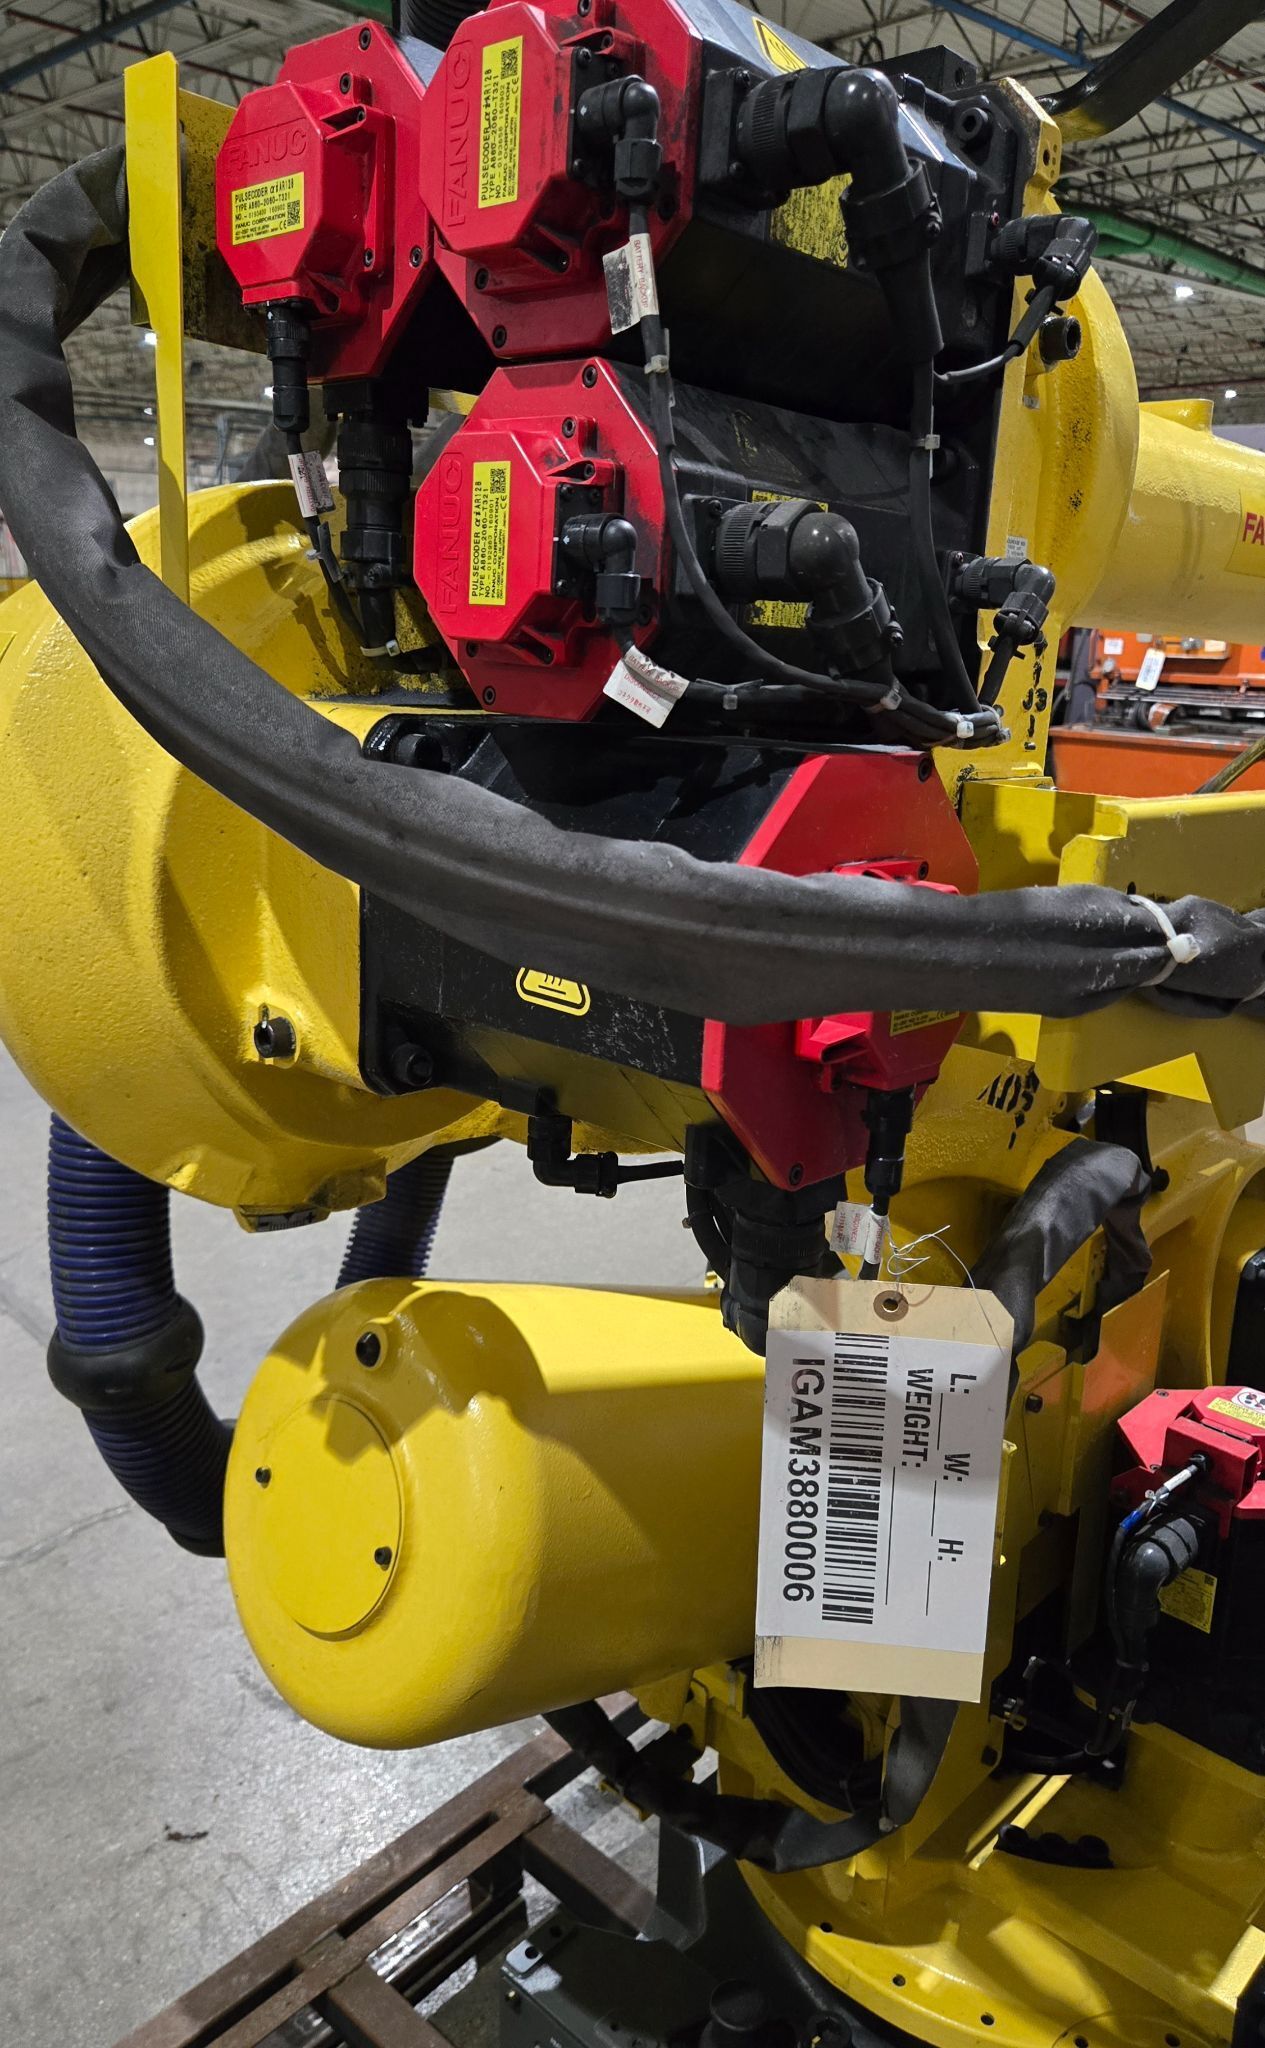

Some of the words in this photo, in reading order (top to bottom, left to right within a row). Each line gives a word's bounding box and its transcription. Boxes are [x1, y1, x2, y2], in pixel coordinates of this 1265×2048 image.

[225, 130, 307, 175] FANUC
[447, 50, 471, 228] FANUC
[481, 127, 489, 200] PULSECODER
[235, 202, 247, 213] TYPE
[439, 459, 463, 615] FANUC
[471, 531, 479, 596] PULSECODER
[950, 1373, 977, 1395] L:
[902, 1368, 934, 1468] WEIGHT:
[783, 1358, 825, 1602] IGAM3880006
[943, 1453, 971, 1482] W:
[937, 1538, 964, 1563] H:
